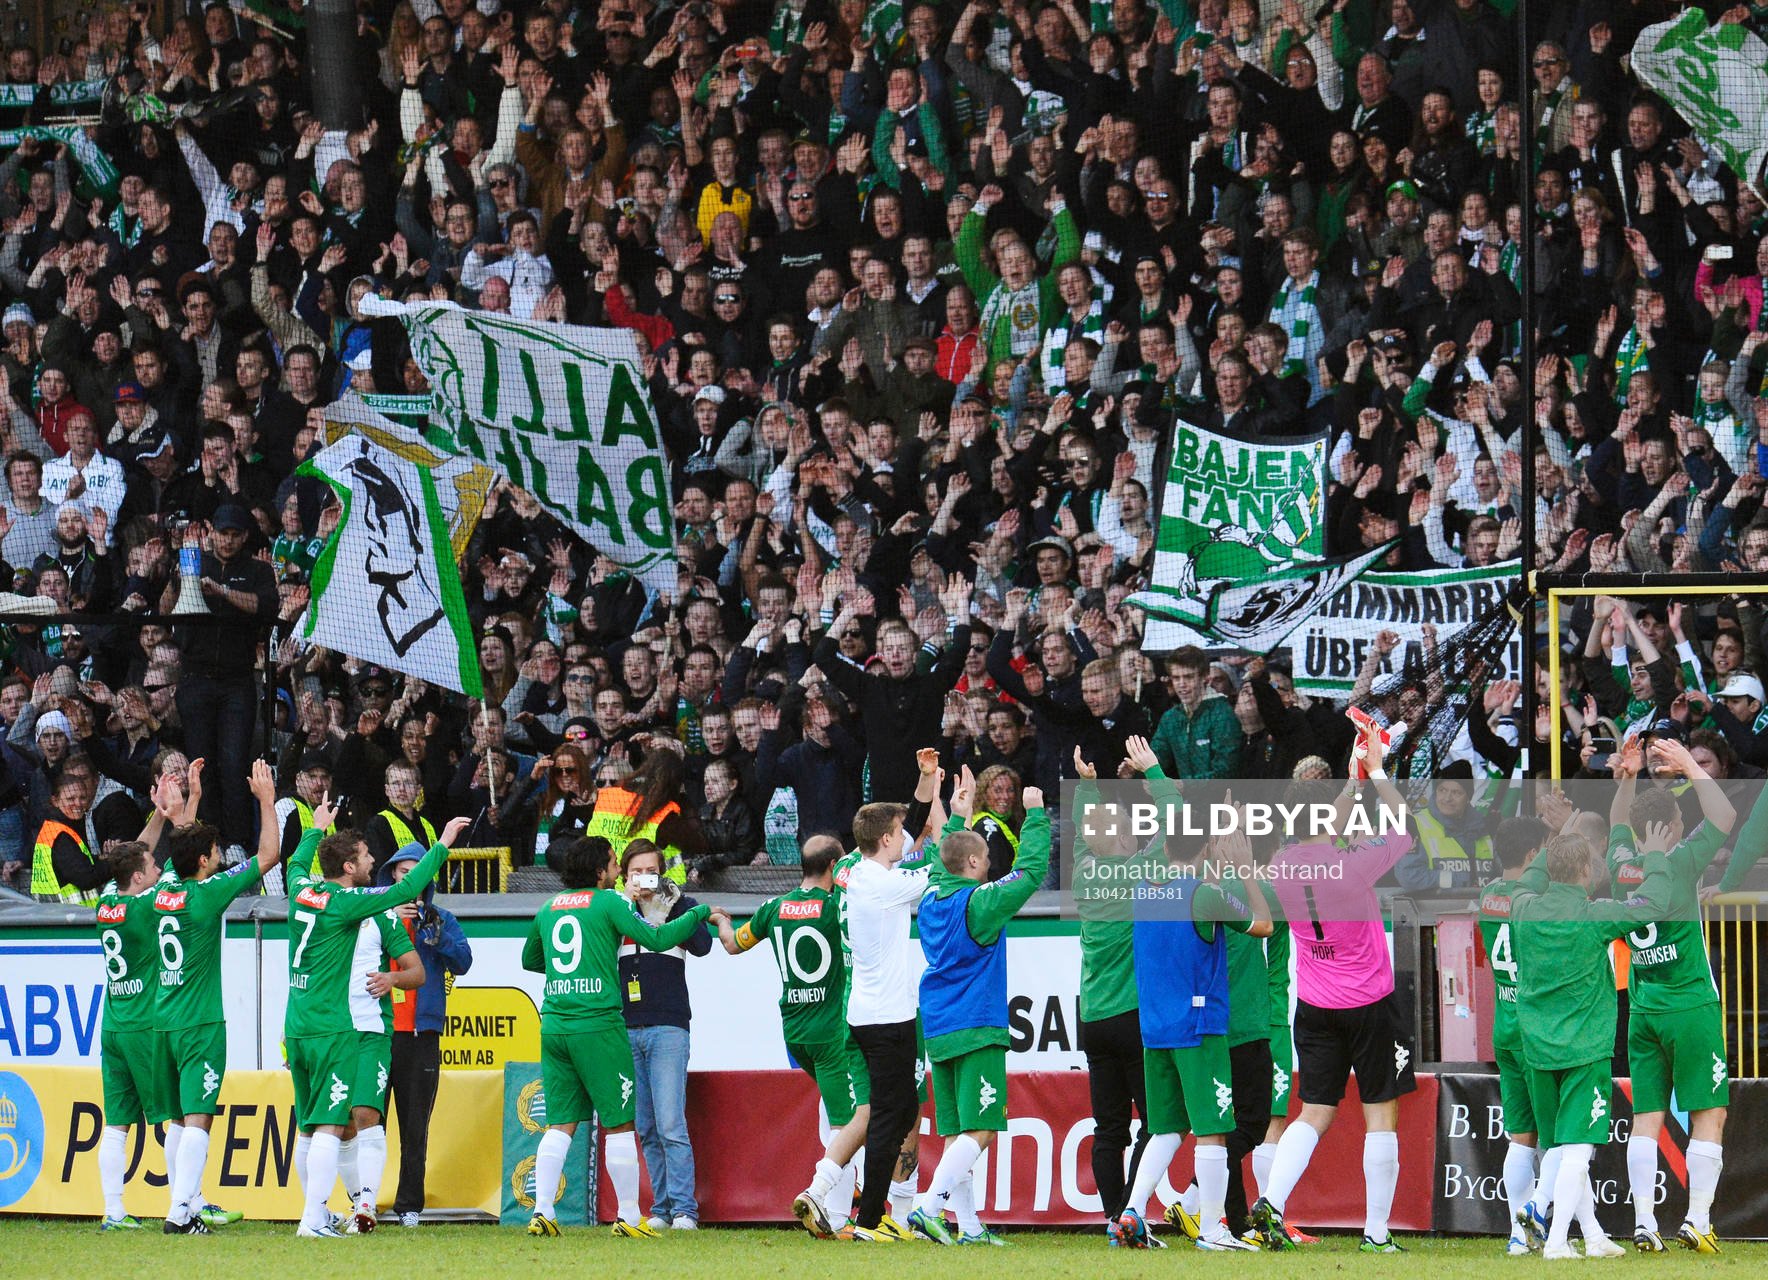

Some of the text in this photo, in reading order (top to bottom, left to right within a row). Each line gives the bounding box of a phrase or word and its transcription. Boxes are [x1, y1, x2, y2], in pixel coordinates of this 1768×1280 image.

[1312, 577, 1521, 624] AMMARBY
[780, 902, 820, 916] FOLKIA
[1303, 885, 1325, 941] 1
[102, 929, 128, 982] 8
[158, 915, 184, 971] 6
[292, 910, 316, 968] 7
[551, 914, 583, 974] 9
[773, 925, 832, 984] 10
[1310, 945, 1336, 961] HOPF
[1491, 923, 1518, 982] 4
[0, 984, 104, 1057] ABV
[787, 986, 826, 1003] KENNEDY
[440, 1015, 517, 1037] MPANIET
[1008, 994, 1085, 1053] SA
[440, 1049, 494, 1065] OLM AB
[61, 1100, 298, 1188] POSEN
